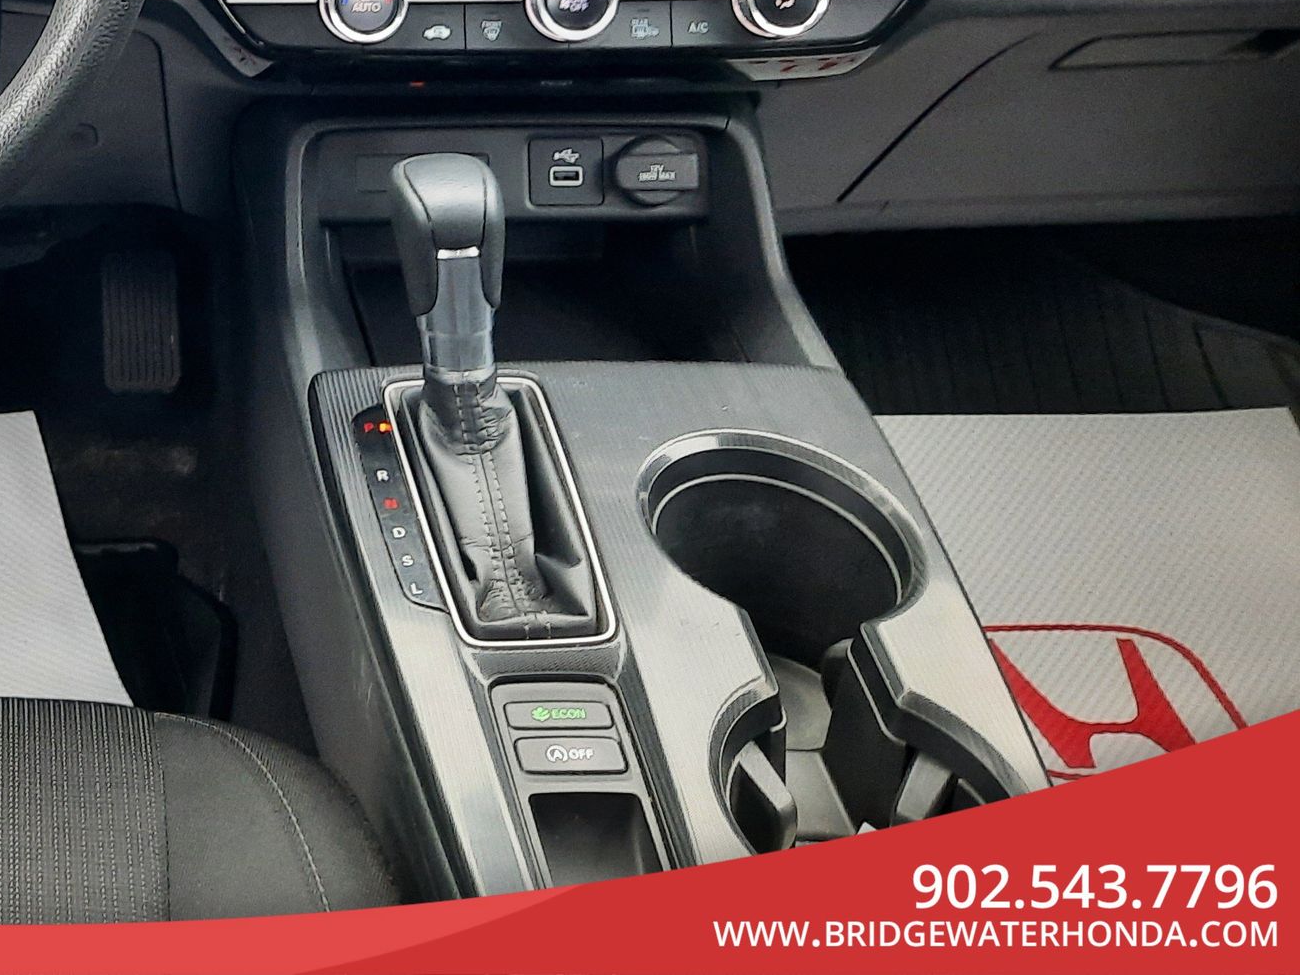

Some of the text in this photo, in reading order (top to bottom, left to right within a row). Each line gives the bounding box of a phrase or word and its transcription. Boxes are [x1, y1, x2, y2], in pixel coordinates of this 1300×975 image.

[352, 2, 382, 13] AUTO
[688, 21, 709, 34] A/C
[376, 470, 390, 482] R
[392, 527, 406, 539] D
[401, 555, 414, 567] S
[410, 582, 423, 595] L
[552, 707, 586, 720] ECON
[568, 748, 594, 760] OFF
